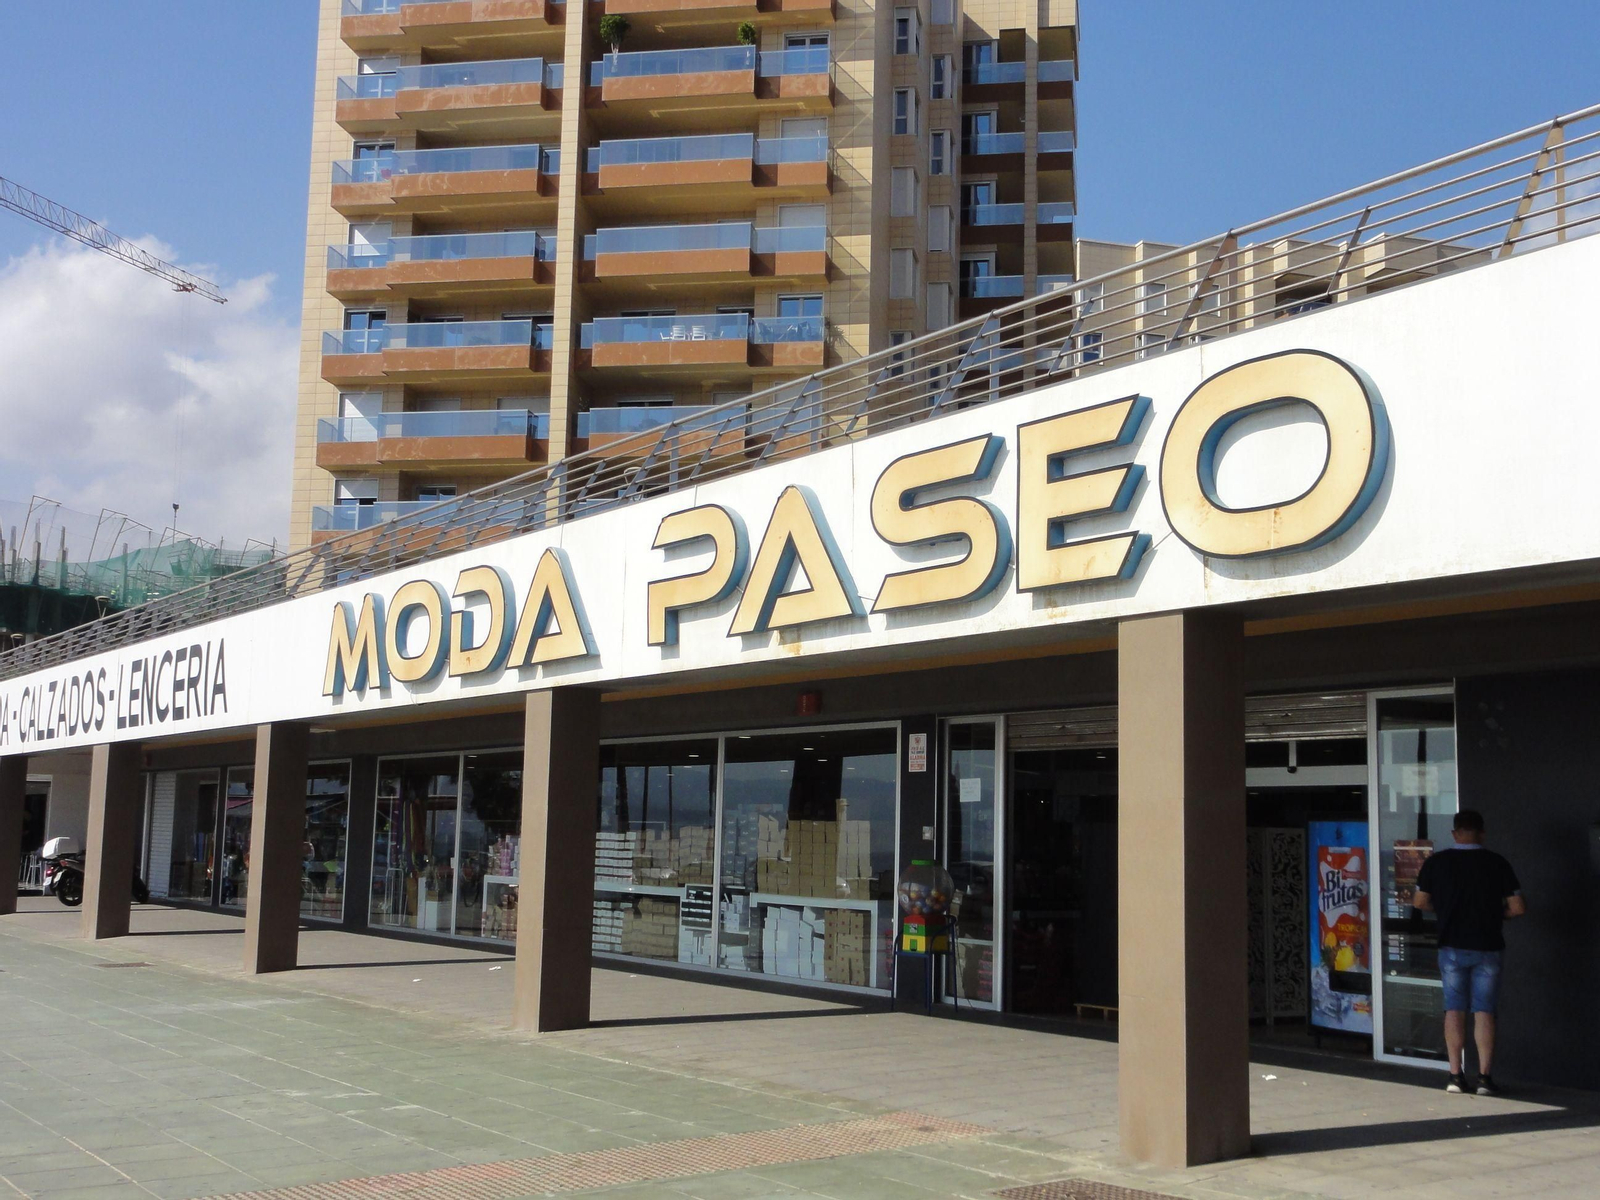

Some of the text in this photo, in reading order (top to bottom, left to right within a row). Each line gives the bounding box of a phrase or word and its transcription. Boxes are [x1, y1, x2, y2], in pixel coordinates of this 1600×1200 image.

[322, 348, 1391, 697] MODA PASEO
[0, 638, 228, 746] A CALZADOS LENCERIA
[1321, 882, 1364, 912] frutas
[1325, 870, 1341, 893] Bi
